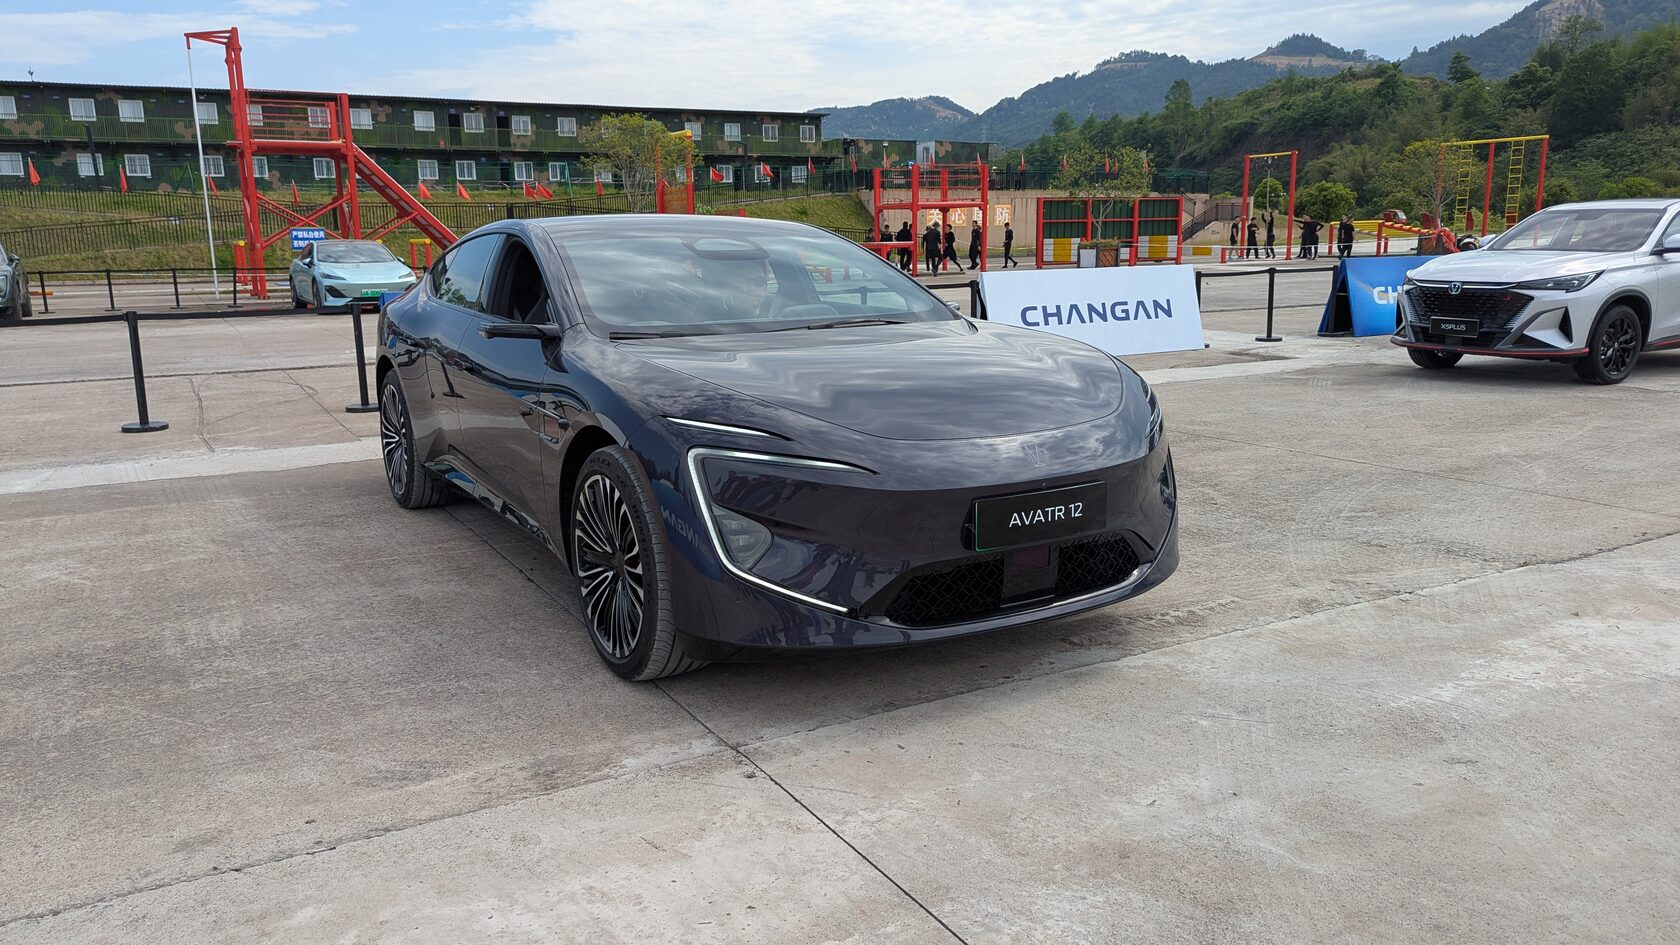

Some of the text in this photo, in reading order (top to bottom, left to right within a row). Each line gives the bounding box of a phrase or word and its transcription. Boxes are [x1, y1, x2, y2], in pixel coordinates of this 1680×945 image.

[1373, 286, 1402, 304] CH
[1020, 298, 1173, 327] CHANGAN
[1009, 502, 1083, 528] AVATR 12
